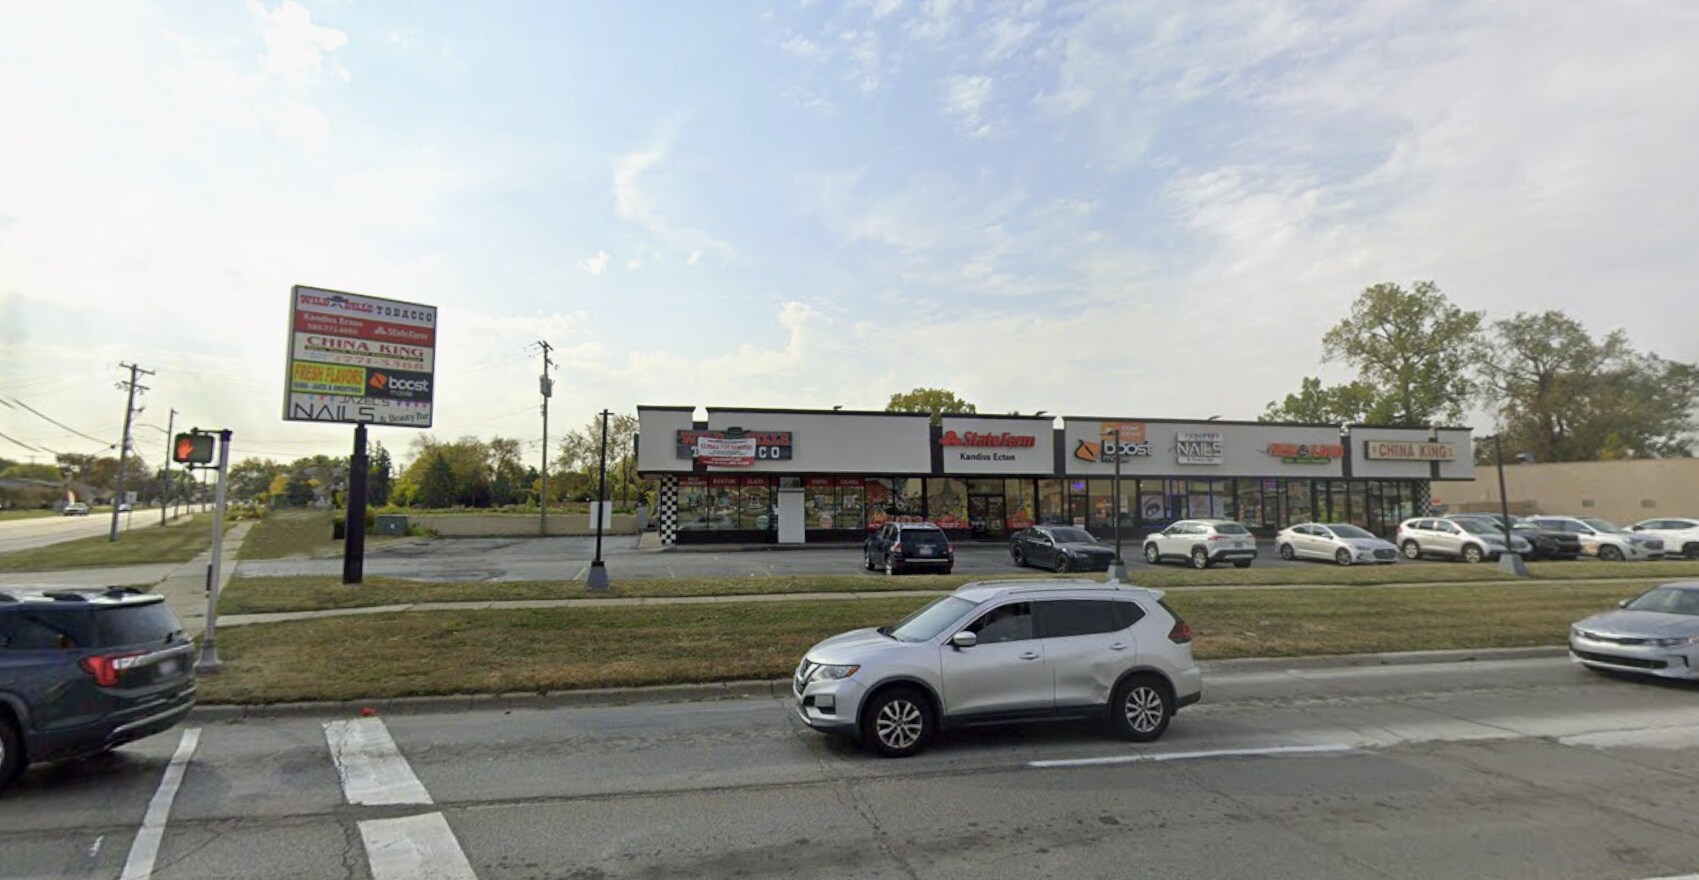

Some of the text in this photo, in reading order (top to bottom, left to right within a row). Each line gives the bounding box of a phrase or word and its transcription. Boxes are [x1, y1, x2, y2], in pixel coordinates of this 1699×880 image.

[376, 305, 432, 322] TOBACCO
[306, 335, 370, 352] CHINA
[380, 343, 424, 359] KING
[388, 375, 429, 391] boost
[293, 402, 375, 421] NAILS
[960, 452, 1016, 461] Kandiss Ecton
[1177, 442, 1223, 457] NAILS
[1419, 444, 1447, 458] KING
